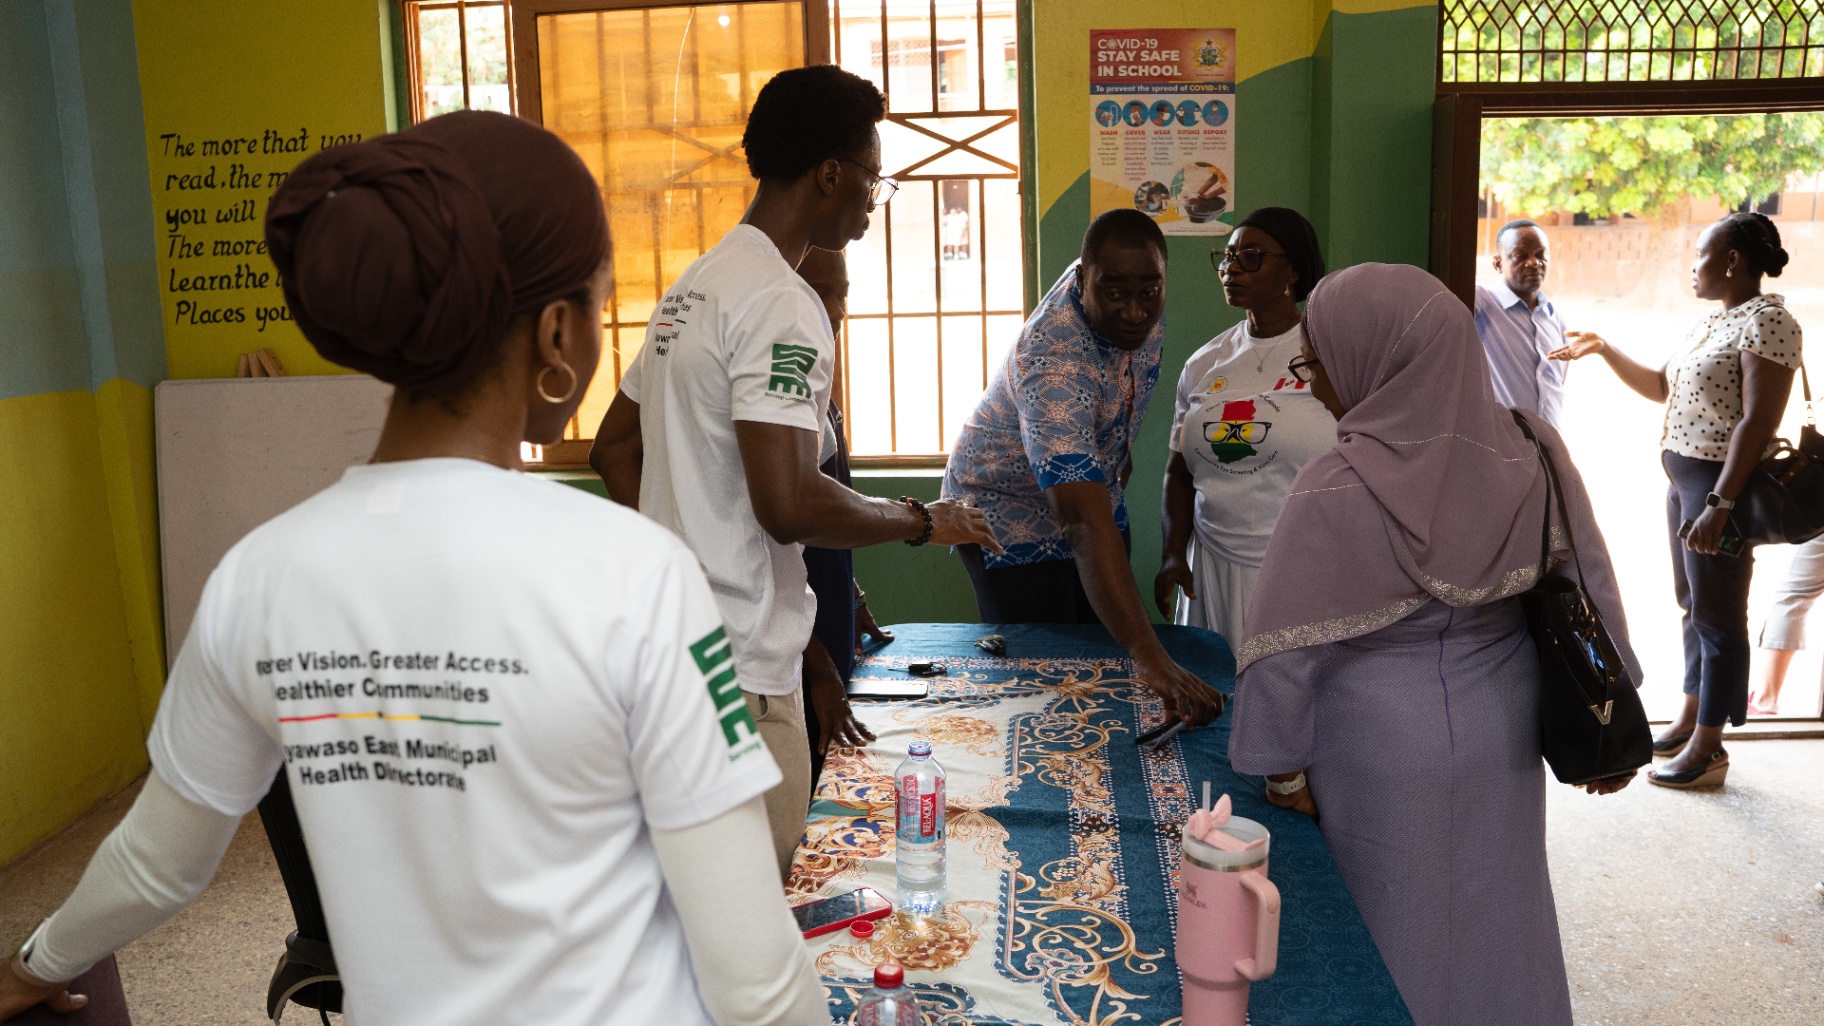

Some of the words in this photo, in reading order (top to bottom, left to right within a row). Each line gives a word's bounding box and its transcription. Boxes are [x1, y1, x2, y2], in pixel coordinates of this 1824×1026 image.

[1098, 50, 1137, 62] STAY
[1141, 50, 1180, 62] SAFE
[1098, 65, 1114, 76] IN
[1118, 65, 1182, 76] SCHOOL
[1152, 85, 1178, 93] spread
[1189, 84, 1230, 92] COVID-19:
[160, 132, 195, 158] The
[202, 140, 257, 156] more
[263, 128, 309, 154] that
[229, 164, 262, 189] the
[166, 206, 208, 233] you
[216, 200, 256, 223] will
[168, 234, 205, 259] The
[212, 239, 268, 257] more
[175, 300, 246, 325] Places
[298, 650, 367, 672] Vision.
[370, 650, 440, 671] Greater
[444, 652, 529, 675] Access.
[277, 678, 355, 702] ealthier
[284, 739, 359, 764] yawaso
[300, 762, 369, 785] Health
